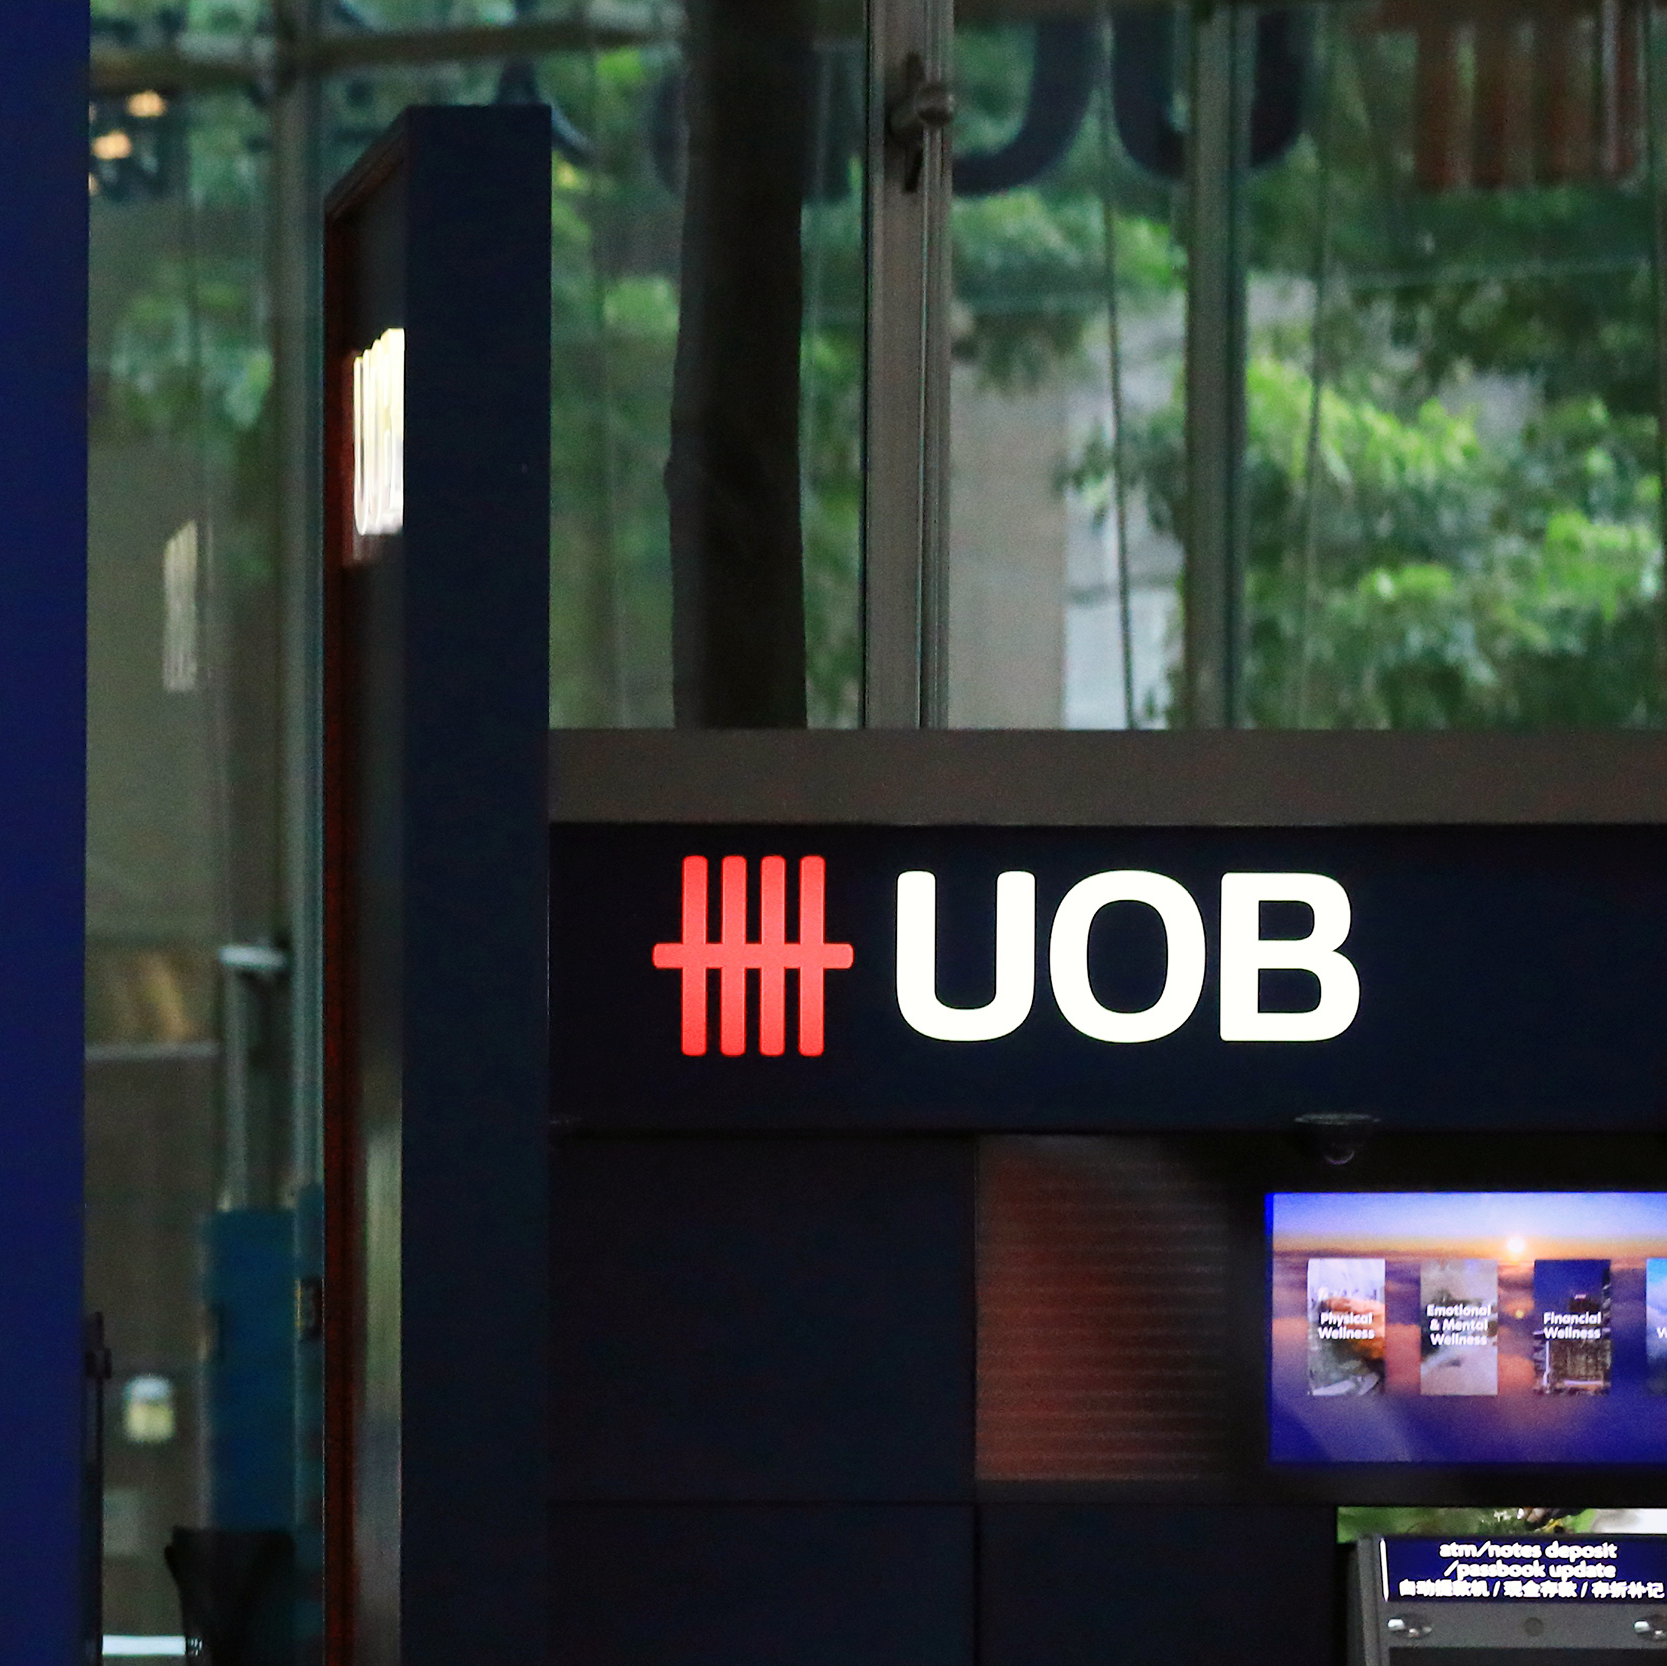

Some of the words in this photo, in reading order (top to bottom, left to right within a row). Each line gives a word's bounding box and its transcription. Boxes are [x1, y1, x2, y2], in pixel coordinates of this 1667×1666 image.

[895, 869, 1362, 1043] UOB
[1426, 1304, 1492, 1317] Emotional
[1320, 1312, 1373, 1327] Physical
[1430, 1319, 1441, 1331] &
[1443, 1318, 1488, 1331] Mental
[1543, 1311, 1602, 1325] Financial
[1318, 1326, 1375, 1340] Wellness
[1430, 1333, 1488, 1346] Wellness
[1543, 1326, 1601, 1339] Wellness
[1439, 1541, 1543, 1559] atm/notes
[1545, 1541, 1618, 1563] deposit
[1549, 1560, 1617, 1582] update
